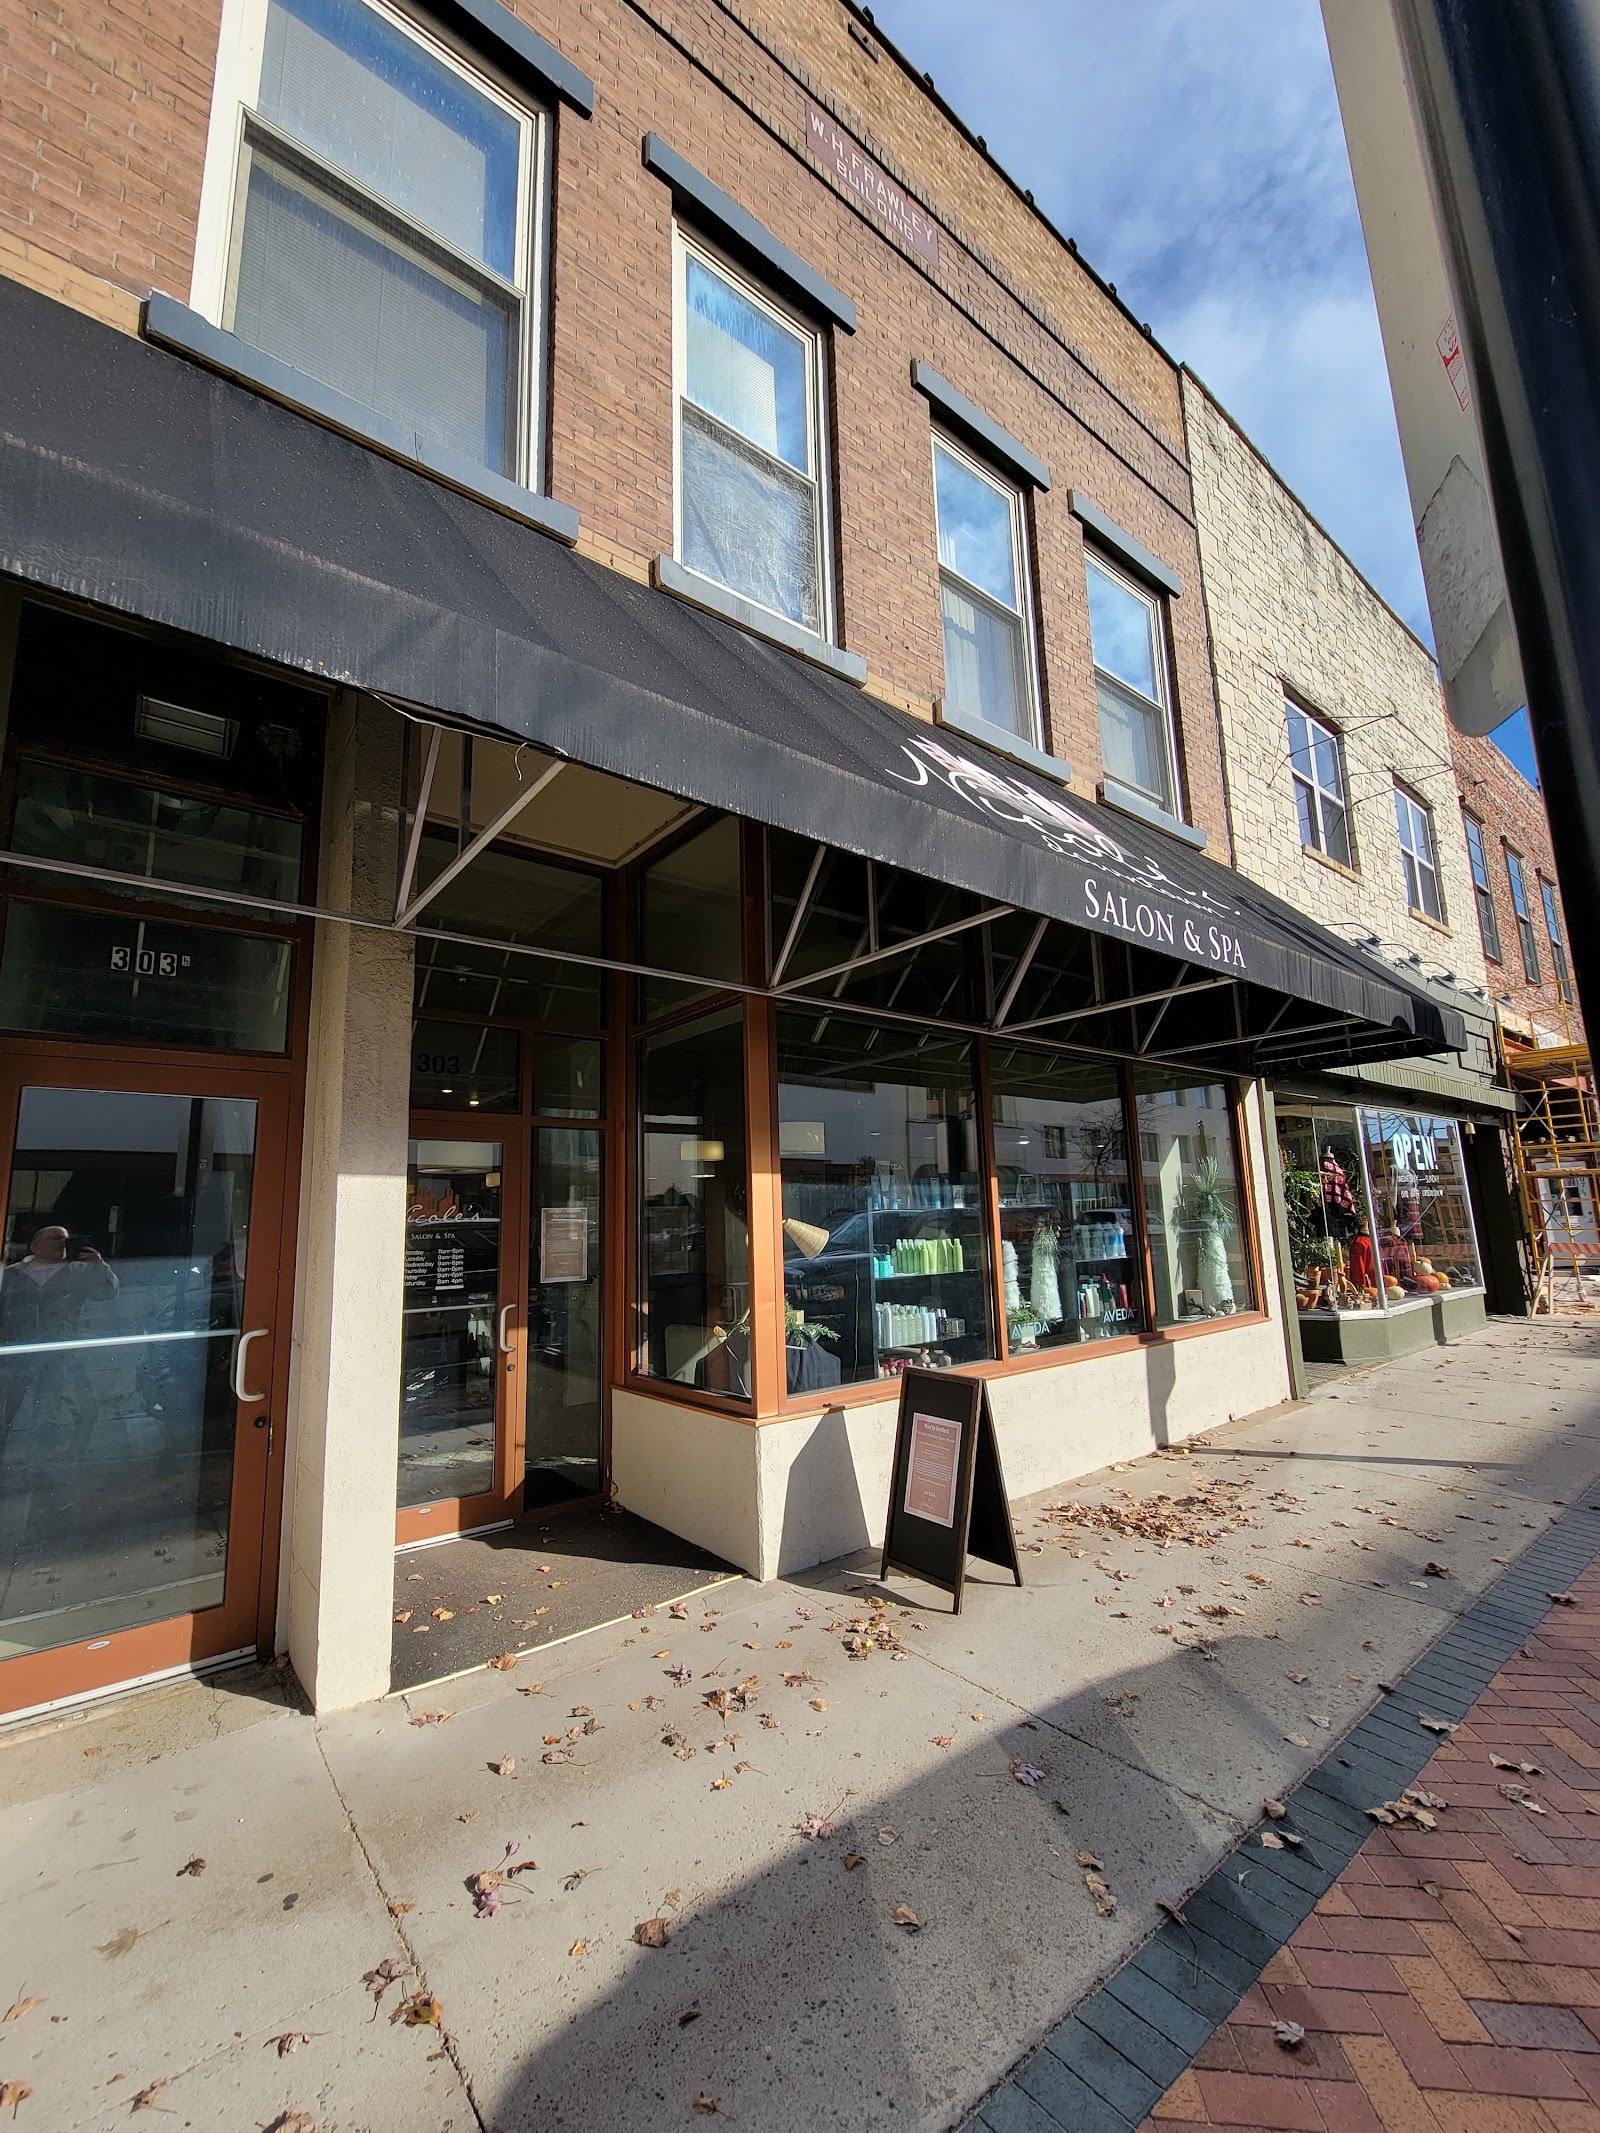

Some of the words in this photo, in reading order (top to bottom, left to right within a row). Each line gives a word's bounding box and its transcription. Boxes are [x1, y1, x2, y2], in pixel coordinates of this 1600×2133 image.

[810, 111, 828, 143] W.
[831, 132, 849, 163] H.
[851, 152, 933, 242] FRAWLEY
[836, 158, 914, 242] BUILDING
[1084, 878, 1175, 945] SALON
[1183, 919, 1204, 955] &
[1208, 926, 1247, 969] SPA
[112, 948, 176, 975] 303
[416, 1053, 460, 1075] 303
[1392, 1132, 1439, 1171] OPEN!
[411, 1232, 434, 1240] SALON
[435, 1232, 442, 1240] &
[405, 1267, 428, 1275] hursday
[1103, 1308, 1135, 1324] AVEDA
